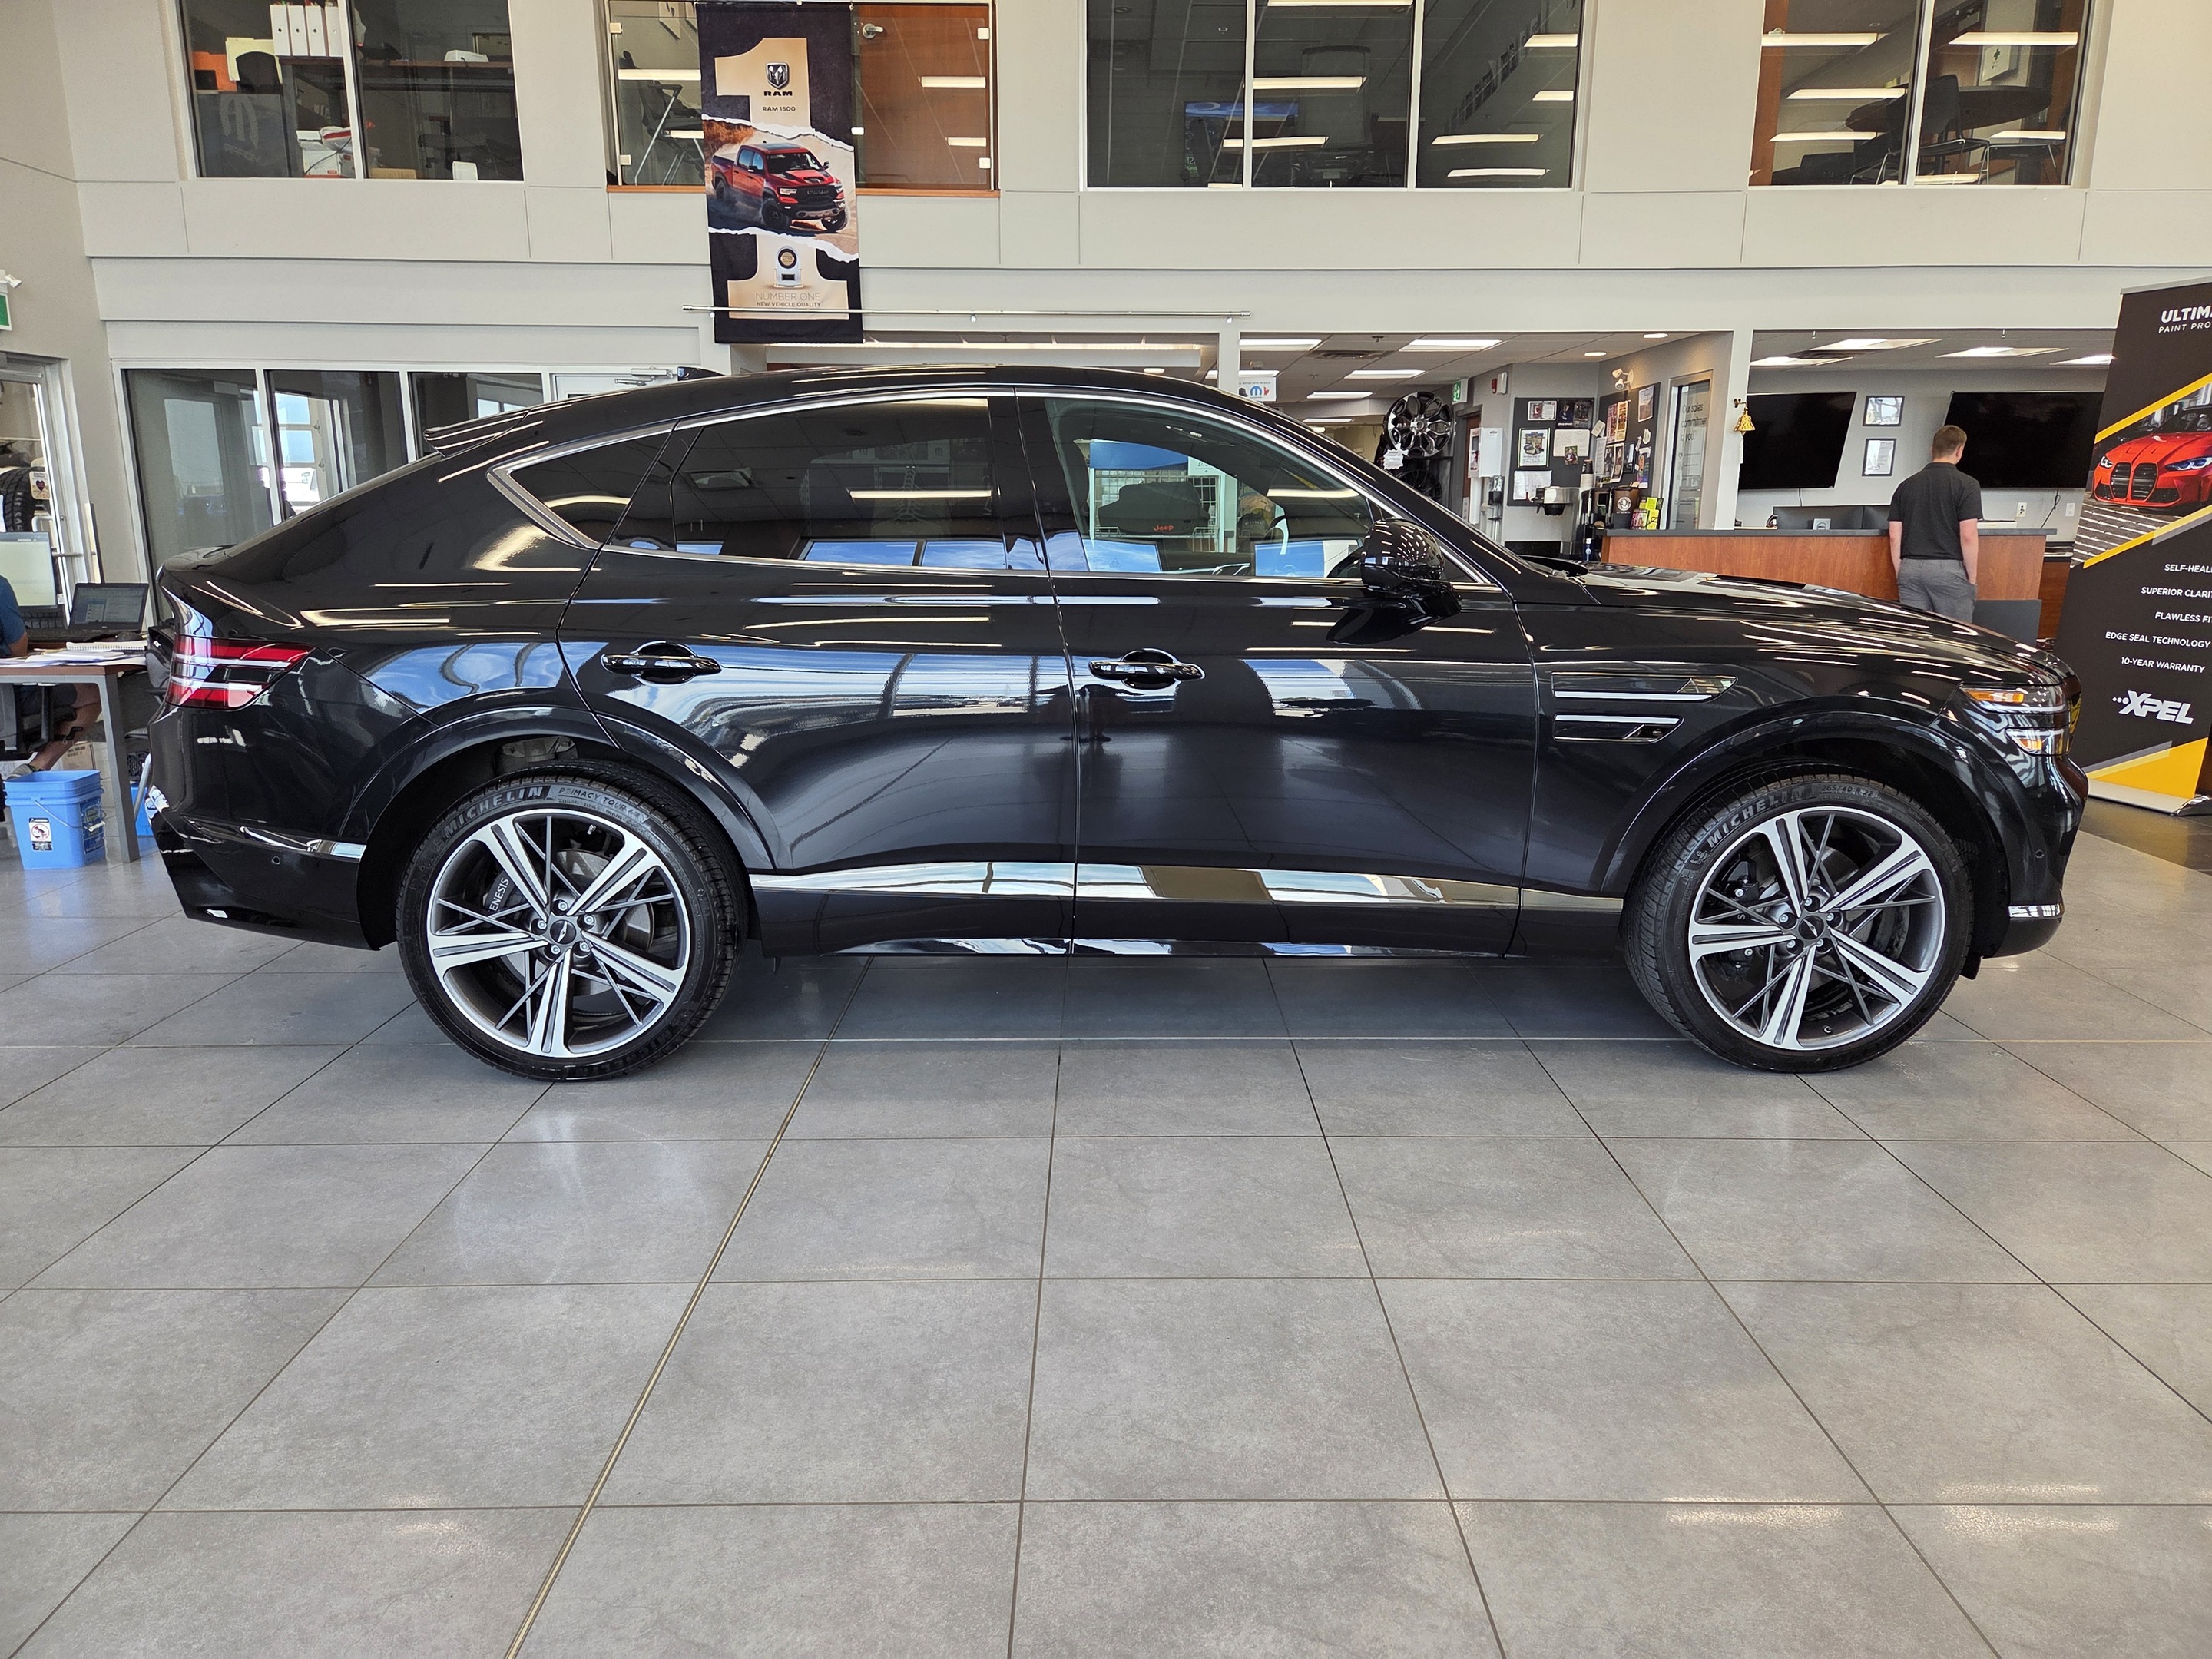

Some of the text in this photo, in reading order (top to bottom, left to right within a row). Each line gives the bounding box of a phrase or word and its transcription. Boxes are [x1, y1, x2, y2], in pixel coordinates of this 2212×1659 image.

[755, 292, 821, 301] NUMBER ONE
[2161, 305, 2212, 323] ULTIM
[2158, 321, 2212, 333] PAINT PRO
[2141, 586, 2184, 597] SUPERIOR
[2154, 611, 2201, 623] FLAWLESS
[2105, 631, 2211, 649] EDGE SEAL TECHNOLOGY
[2121, 657, 2206, 674] 10-YEAR WARRANTY
[2118, 690, 2194, 725] XPEL
[443, 786, 544, 839] MICHELIN
[602, 796, 627, 812] TOUR
[1706, 785, 1806, 848] MICHELIN
[488, 877, 509, 912] ENESIS
